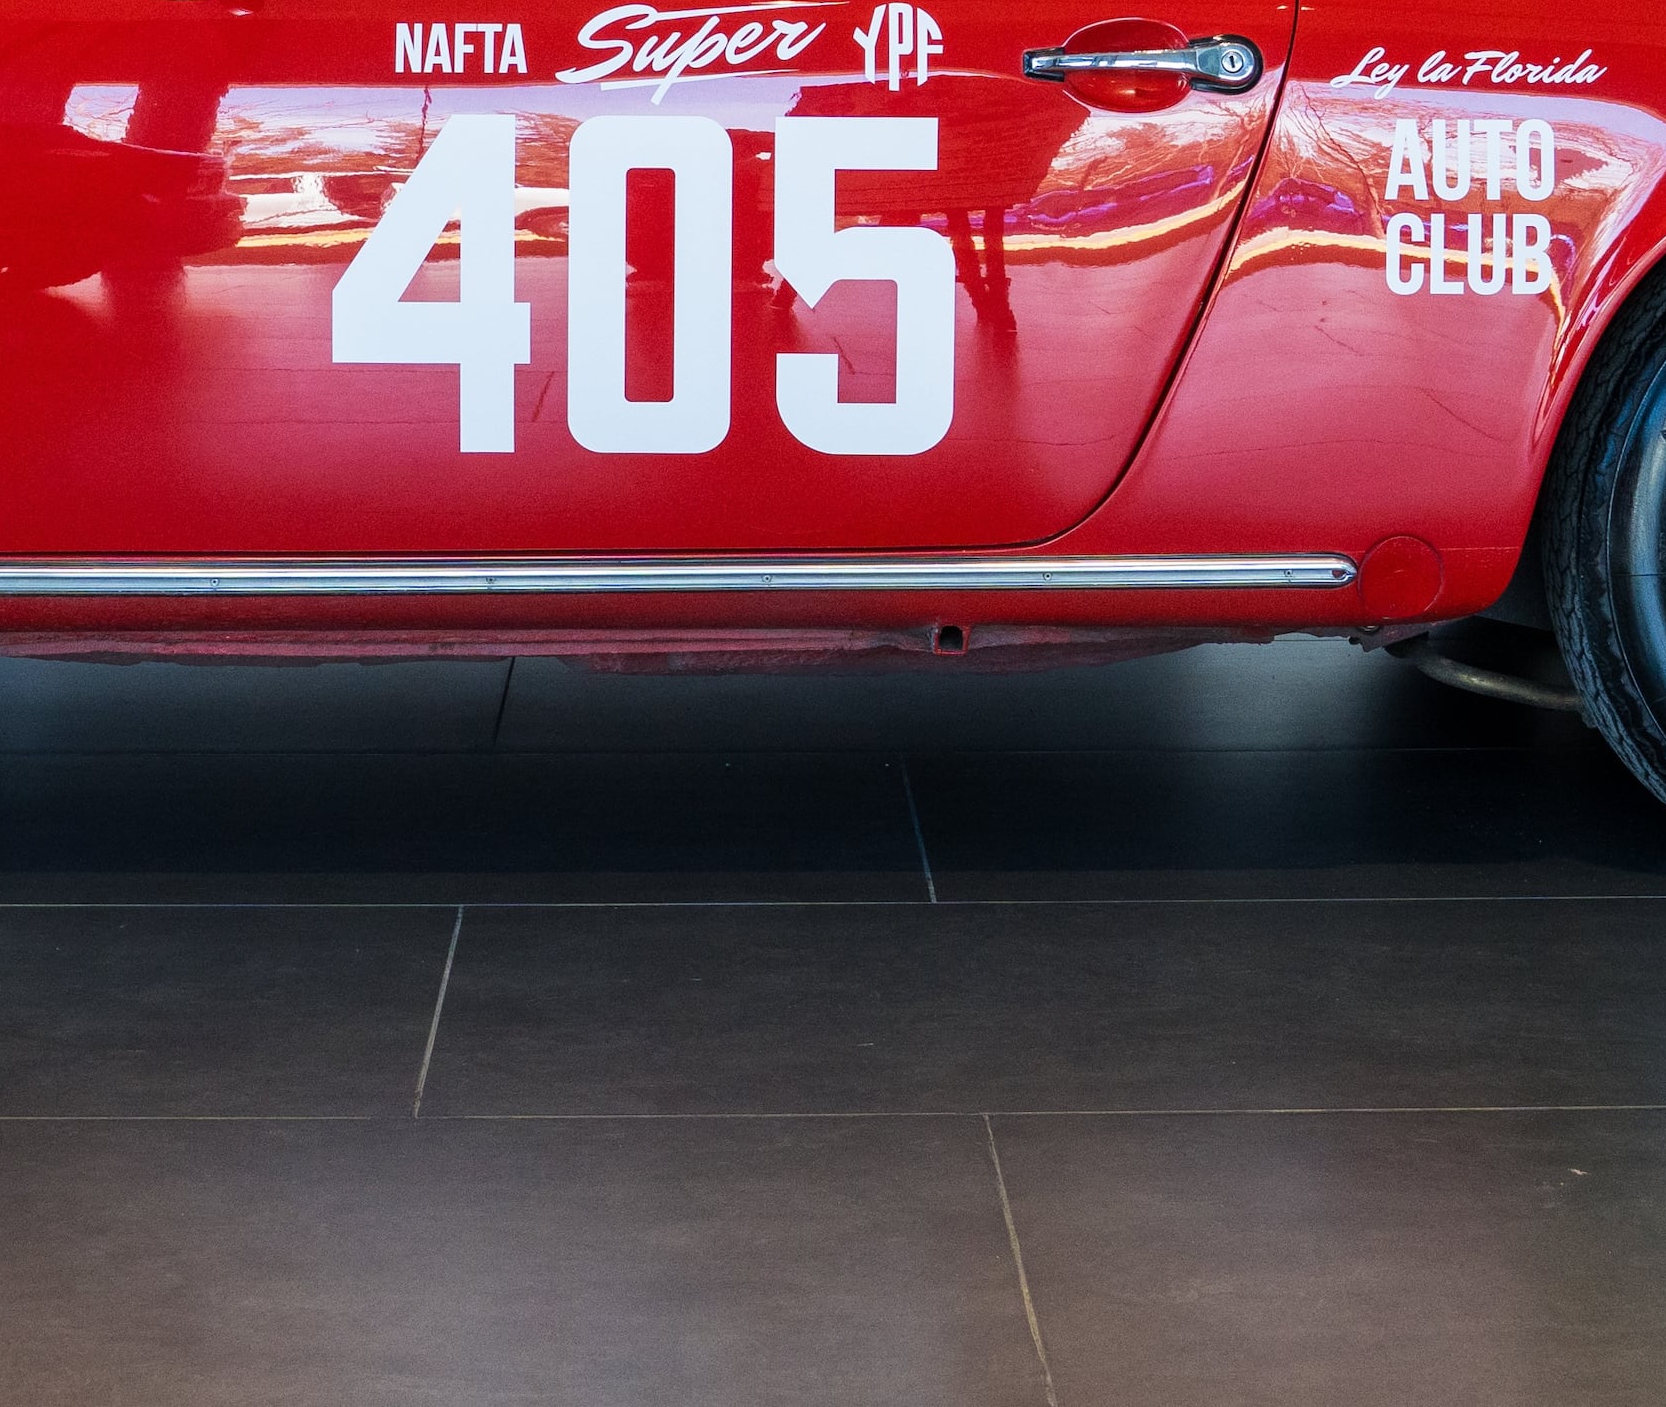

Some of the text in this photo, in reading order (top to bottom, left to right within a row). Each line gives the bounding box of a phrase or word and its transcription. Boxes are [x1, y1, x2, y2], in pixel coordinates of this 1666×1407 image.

[395, 1, 944, 105] NAFTA Super YPF
[1331, 47, 1608, 99] Ley la Florida
[1384, 118, 1555, 201] AUTO
[331, 114, 956, 456] 405
[1385, 212, 1553, 296] CLUB
